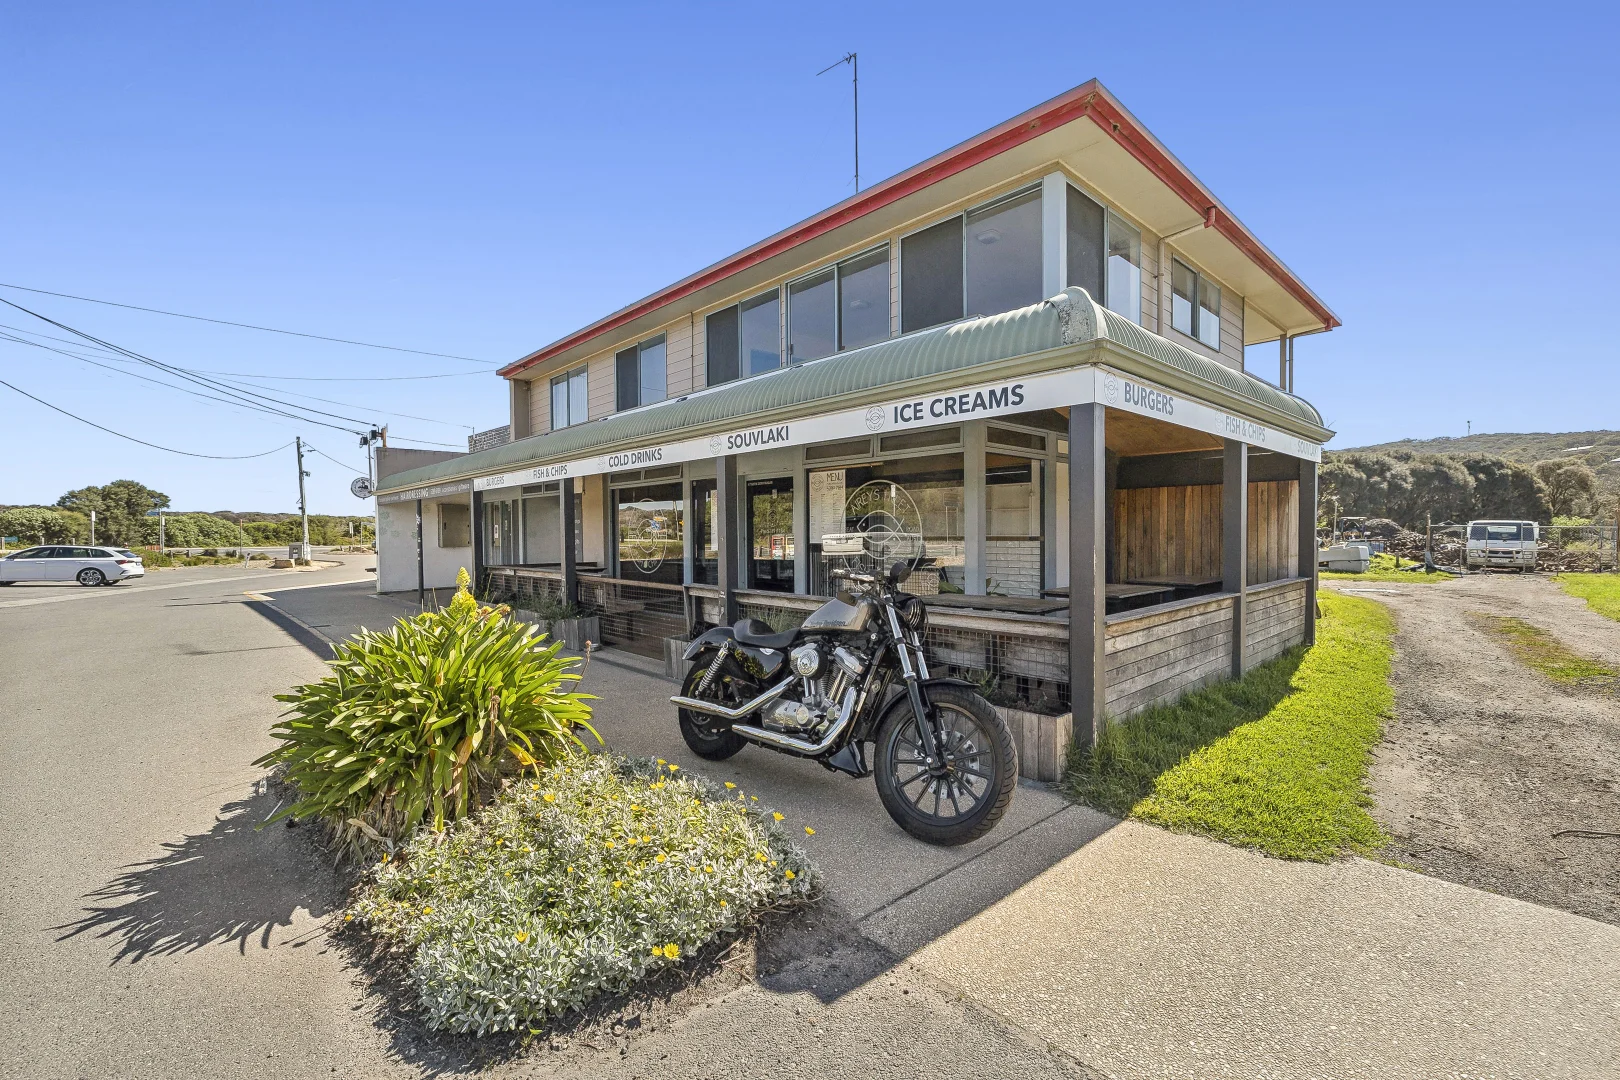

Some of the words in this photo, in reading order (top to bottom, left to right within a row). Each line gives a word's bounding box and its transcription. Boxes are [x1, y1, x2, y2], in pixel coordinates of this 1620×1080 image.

[894, 402, 924, 424] ICE
[929, 385, 1024, 418] CREAMS
[1124, 381, 1174, 416] BURGERS
[727, 426, 790, 449] SOUVLAKI
[1225, 415, 1241, 434] FISH
[1241, 426, 1247, 437] &
[1248, 425, 1266, 443] CHIPS
[608, 454, 629, 468] COLD
[630, 447, 662, 465] DRINKS
[486, 475, 505, 487] BURGERS
[533, 468, 545, 479] FISH
[546, 468, 550, 477] &
[551, 464, 568, 477] CHIPS
[826, 472, 844, 482] MENU
